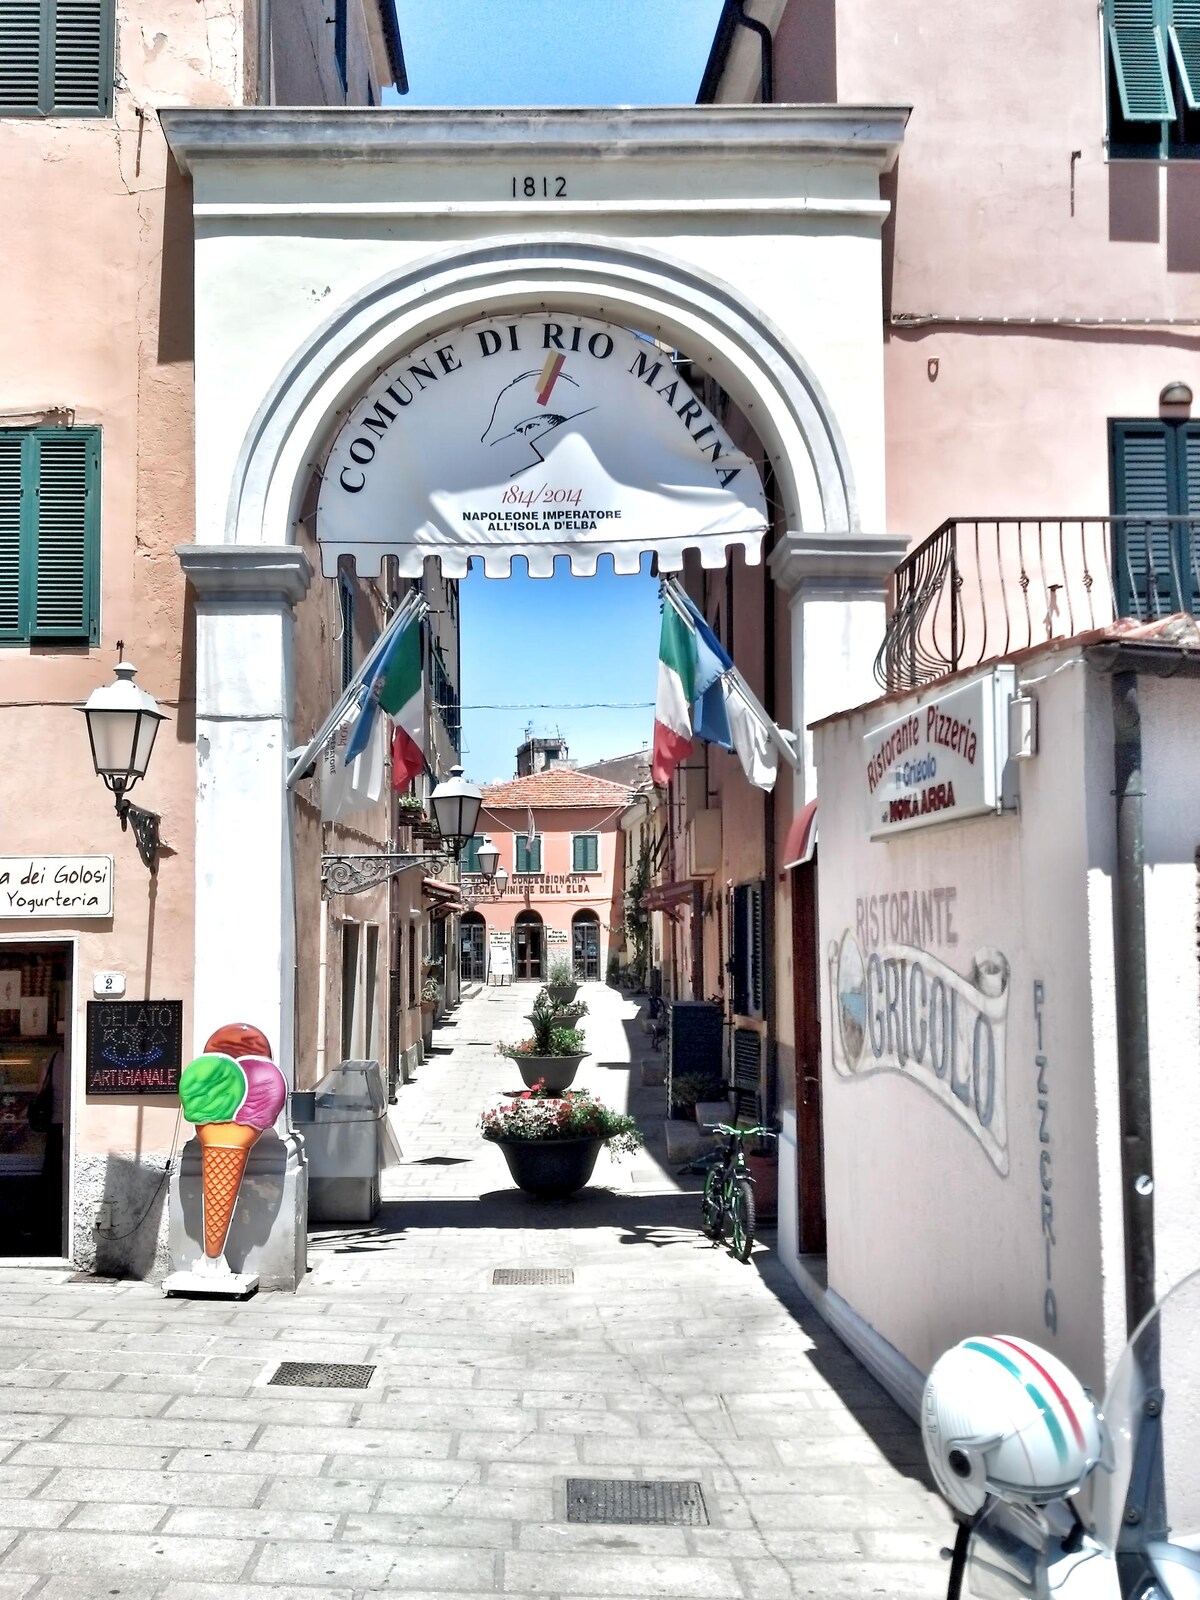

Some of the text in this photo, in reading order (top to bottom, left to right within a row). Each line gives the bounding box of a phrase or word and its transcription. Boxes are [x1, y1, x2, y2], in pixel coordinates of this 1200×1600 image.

[511, 176, 567, 198] 1812
[339, 322, 742, 495] COMUNE DI RIO MARINA
[501, 482, 583, 508] 1814/2014
[462, 510, 622, 521] NAPOLEONE IMPERATORE
[487, 520, 598, 532] ALL'ISOLA D'ELBA
[867, 704, 977, 795] Ristorante Pizzeria
[920, 781, 956, 815] ARRA
[20, 861, 46, 885] dei
[54, 865, 108, 885] Golosi
[6, 890, 99, 913] Yogurteria
[856, 886, 958, 951] RISTORANTE
[105, 977, 113, 990] 2
[98, 1006, 173, 1027] GELATO
[90, 1067, 177, 1087] ARTIGIANALE
